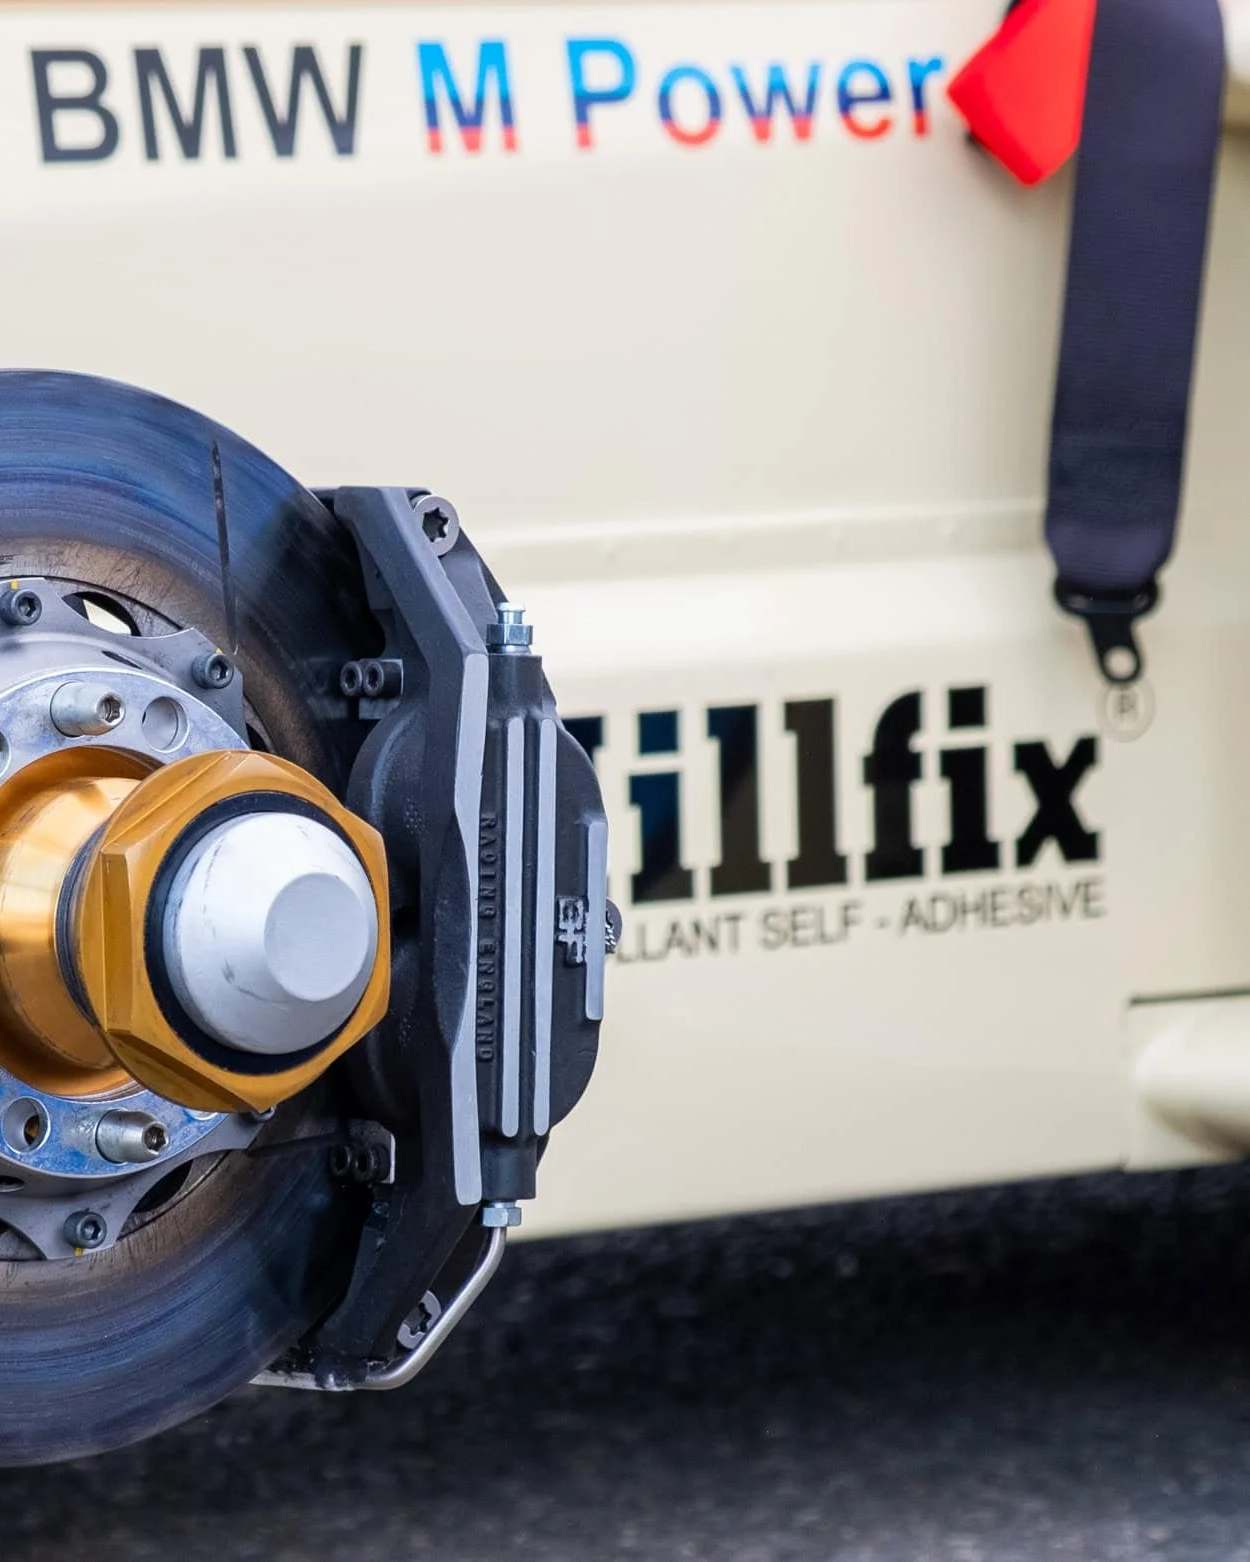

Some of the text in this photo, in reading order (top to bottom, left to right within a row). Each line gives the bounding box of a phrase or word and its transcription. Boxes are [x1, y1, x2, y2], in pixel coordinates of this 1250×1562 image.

[30, 37, 944, 163] BMW M Power
[561, 684, 1101, 904] illfix
[759, 898, 871, 951] SELF
[898, 876, 1108, 937] ADHESIVE
[476, 940, 497, 1063] ENGLAND
